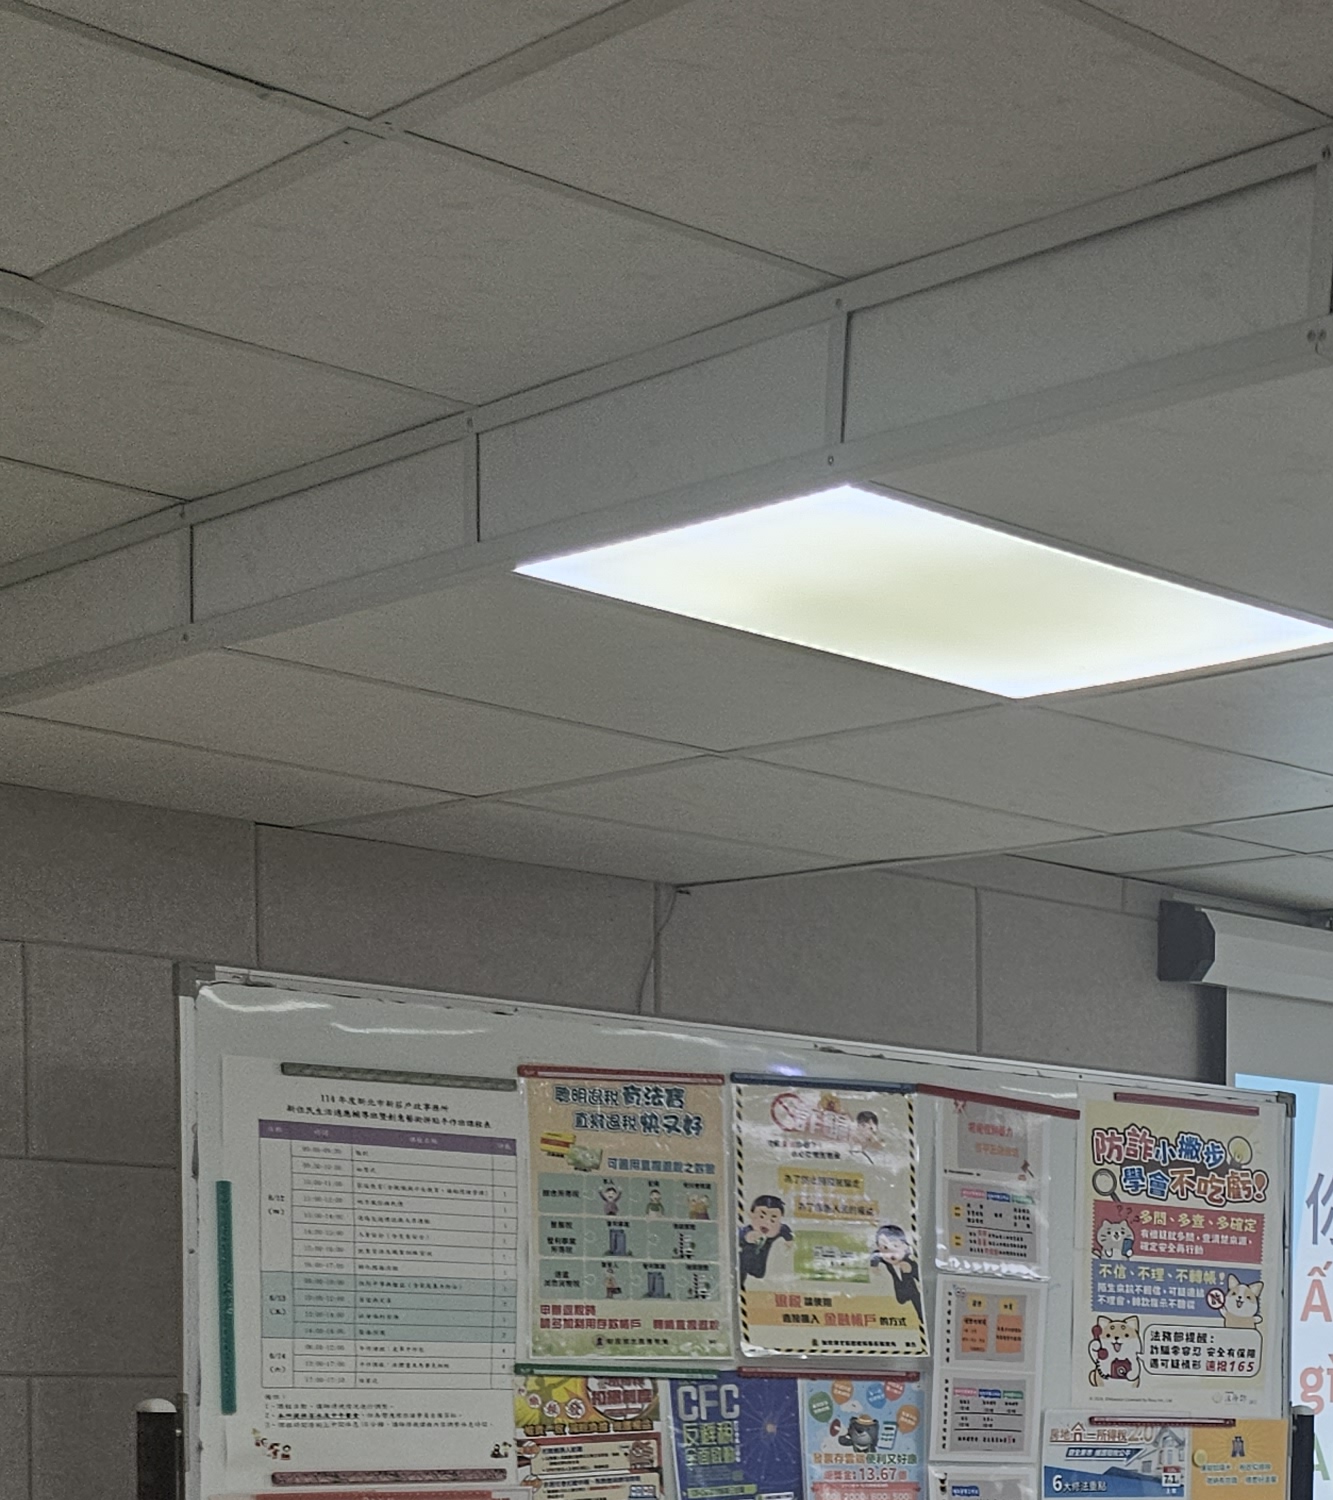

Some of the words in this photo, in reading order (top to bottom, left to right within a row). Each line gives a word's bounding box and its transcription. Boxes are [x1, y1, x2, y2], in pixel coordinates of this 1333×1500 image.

[1093, 1124, 1226, 1169] 防詐小撇步
[1121, 1165, 1268, 1206] 學會不吃虧!
[1140, 1210, 1257, 1233] 多問、多查、多確定
[678, 1384, 740, 1421] CFC
